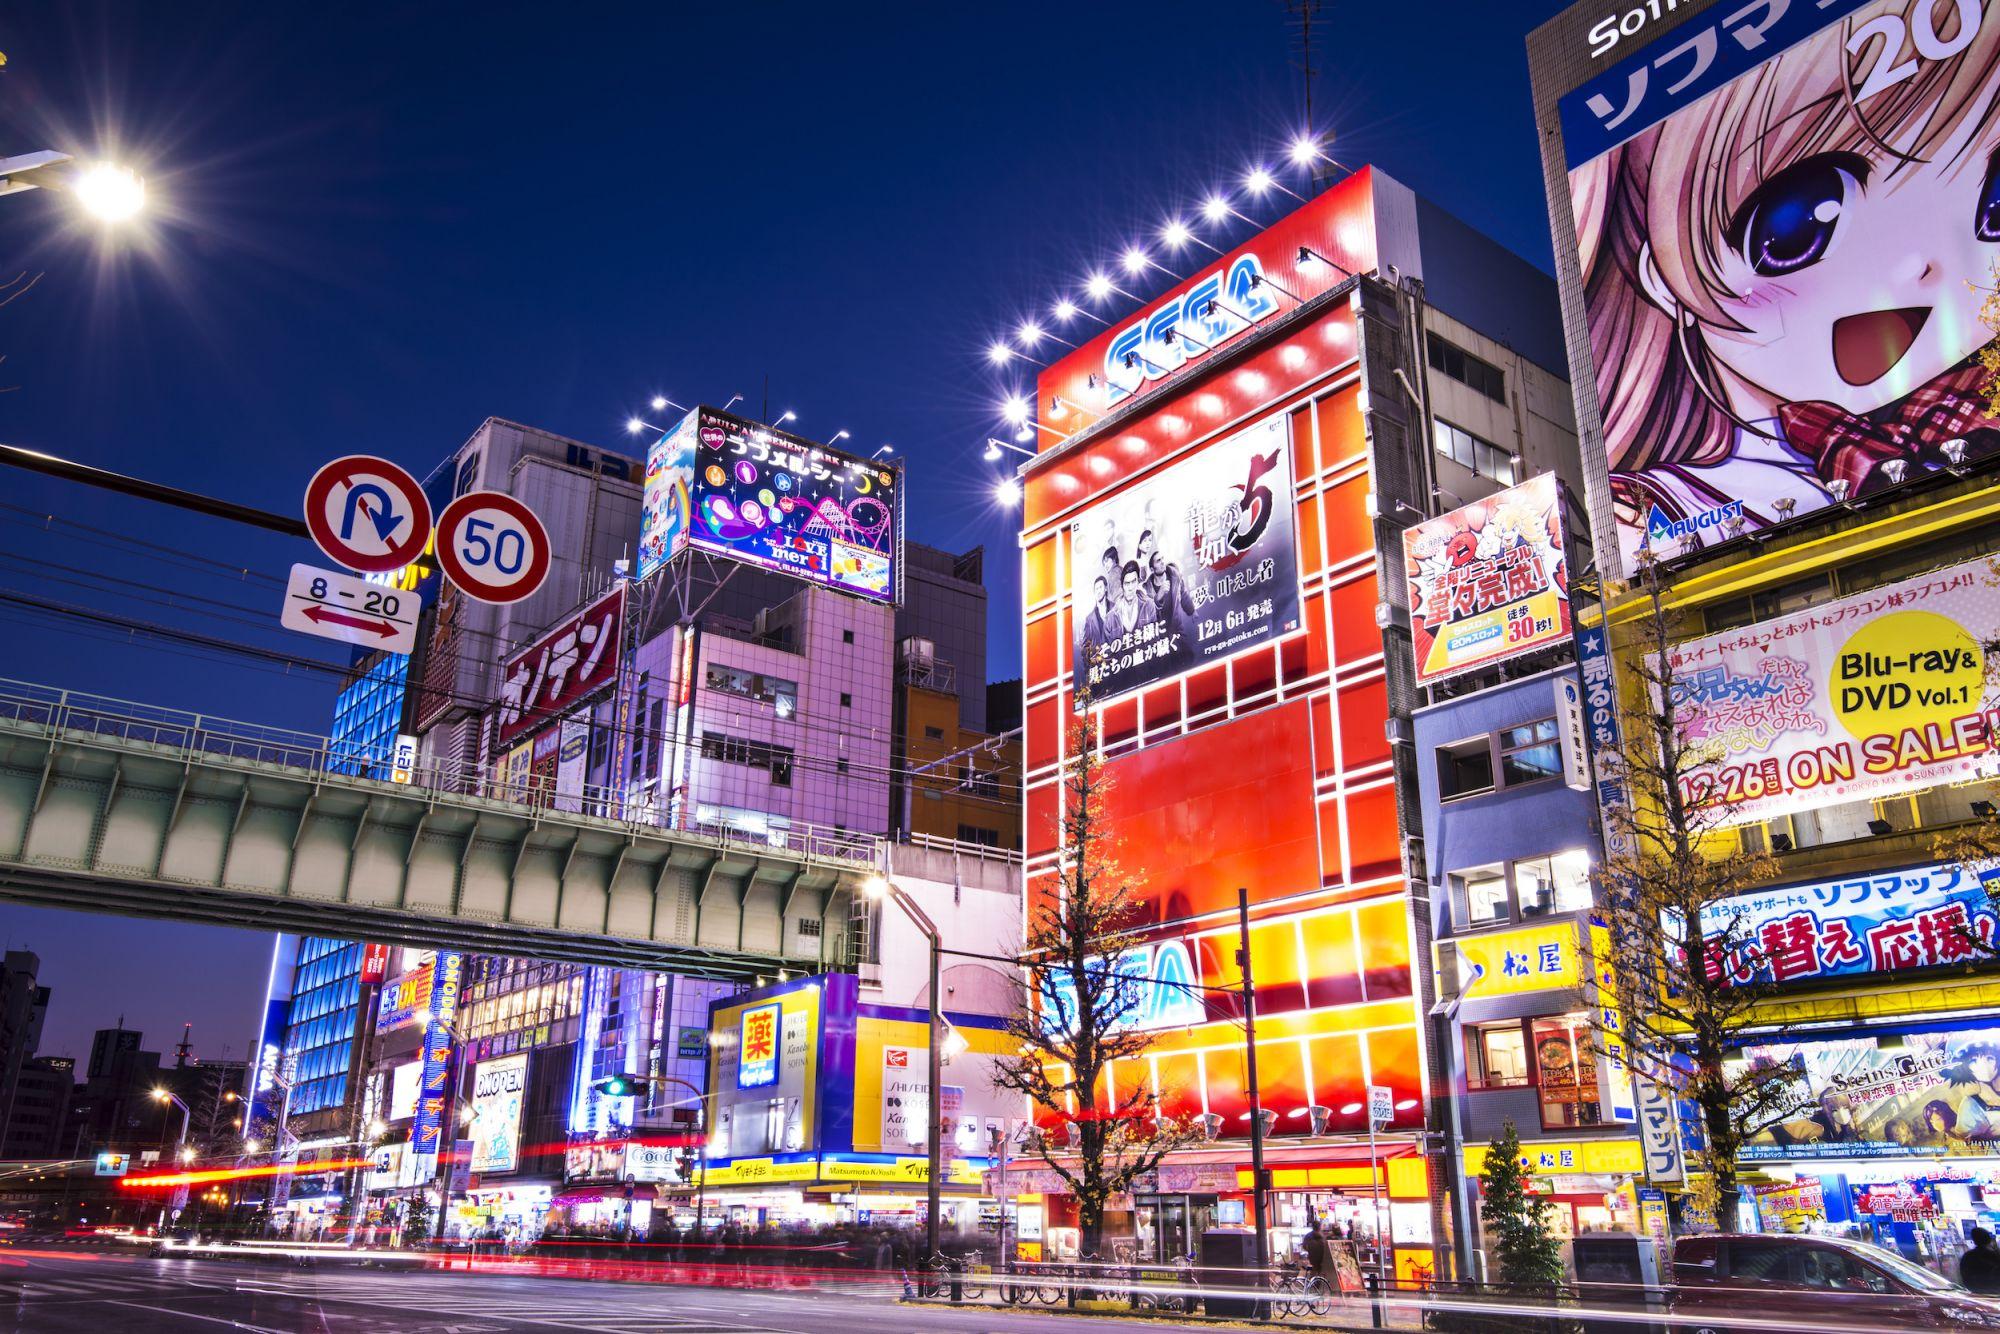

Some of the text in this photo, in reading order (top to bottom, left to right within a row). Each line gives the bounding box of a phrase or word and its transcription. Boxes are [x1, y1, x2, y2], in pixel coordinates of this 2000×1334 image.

[1104, 253, 1280, 409] SEGA
[726, 434, 845, 483] ラブメルシー
[1673, 499, 1744, 537] AUGUST
[462, 517, 525, 575] 50
[1507, 605, 1529, 621] 徒歩
[1099, 620, 1167, 658] その生き様に
[1204, 624, 1269, 655] ryu-ga-gotoku.com
[498, 612, 613, 727] オノデン
[1760, 659, 1808, 679] だけど
[1582, 654, 1613, 743] 売るのも
[1841, 682, 1912, 714] DVD
[1787, 741, 1856, 789] ON
[1752, 895, 1808, 911] サポートも
[1813, 864, 1962, 908] ソフマップ
[1503, 942, 1563, 978] 松屋
[747, 1011, 772, 1059] 薬
[1603, 1008, 1624, 1072] 松屋
[475, 1067, 524, 1098] ONODEN
[828, 1166, 870, 1176] Matsumoto
[1539, 1150, 1574, 1168] 松屋
